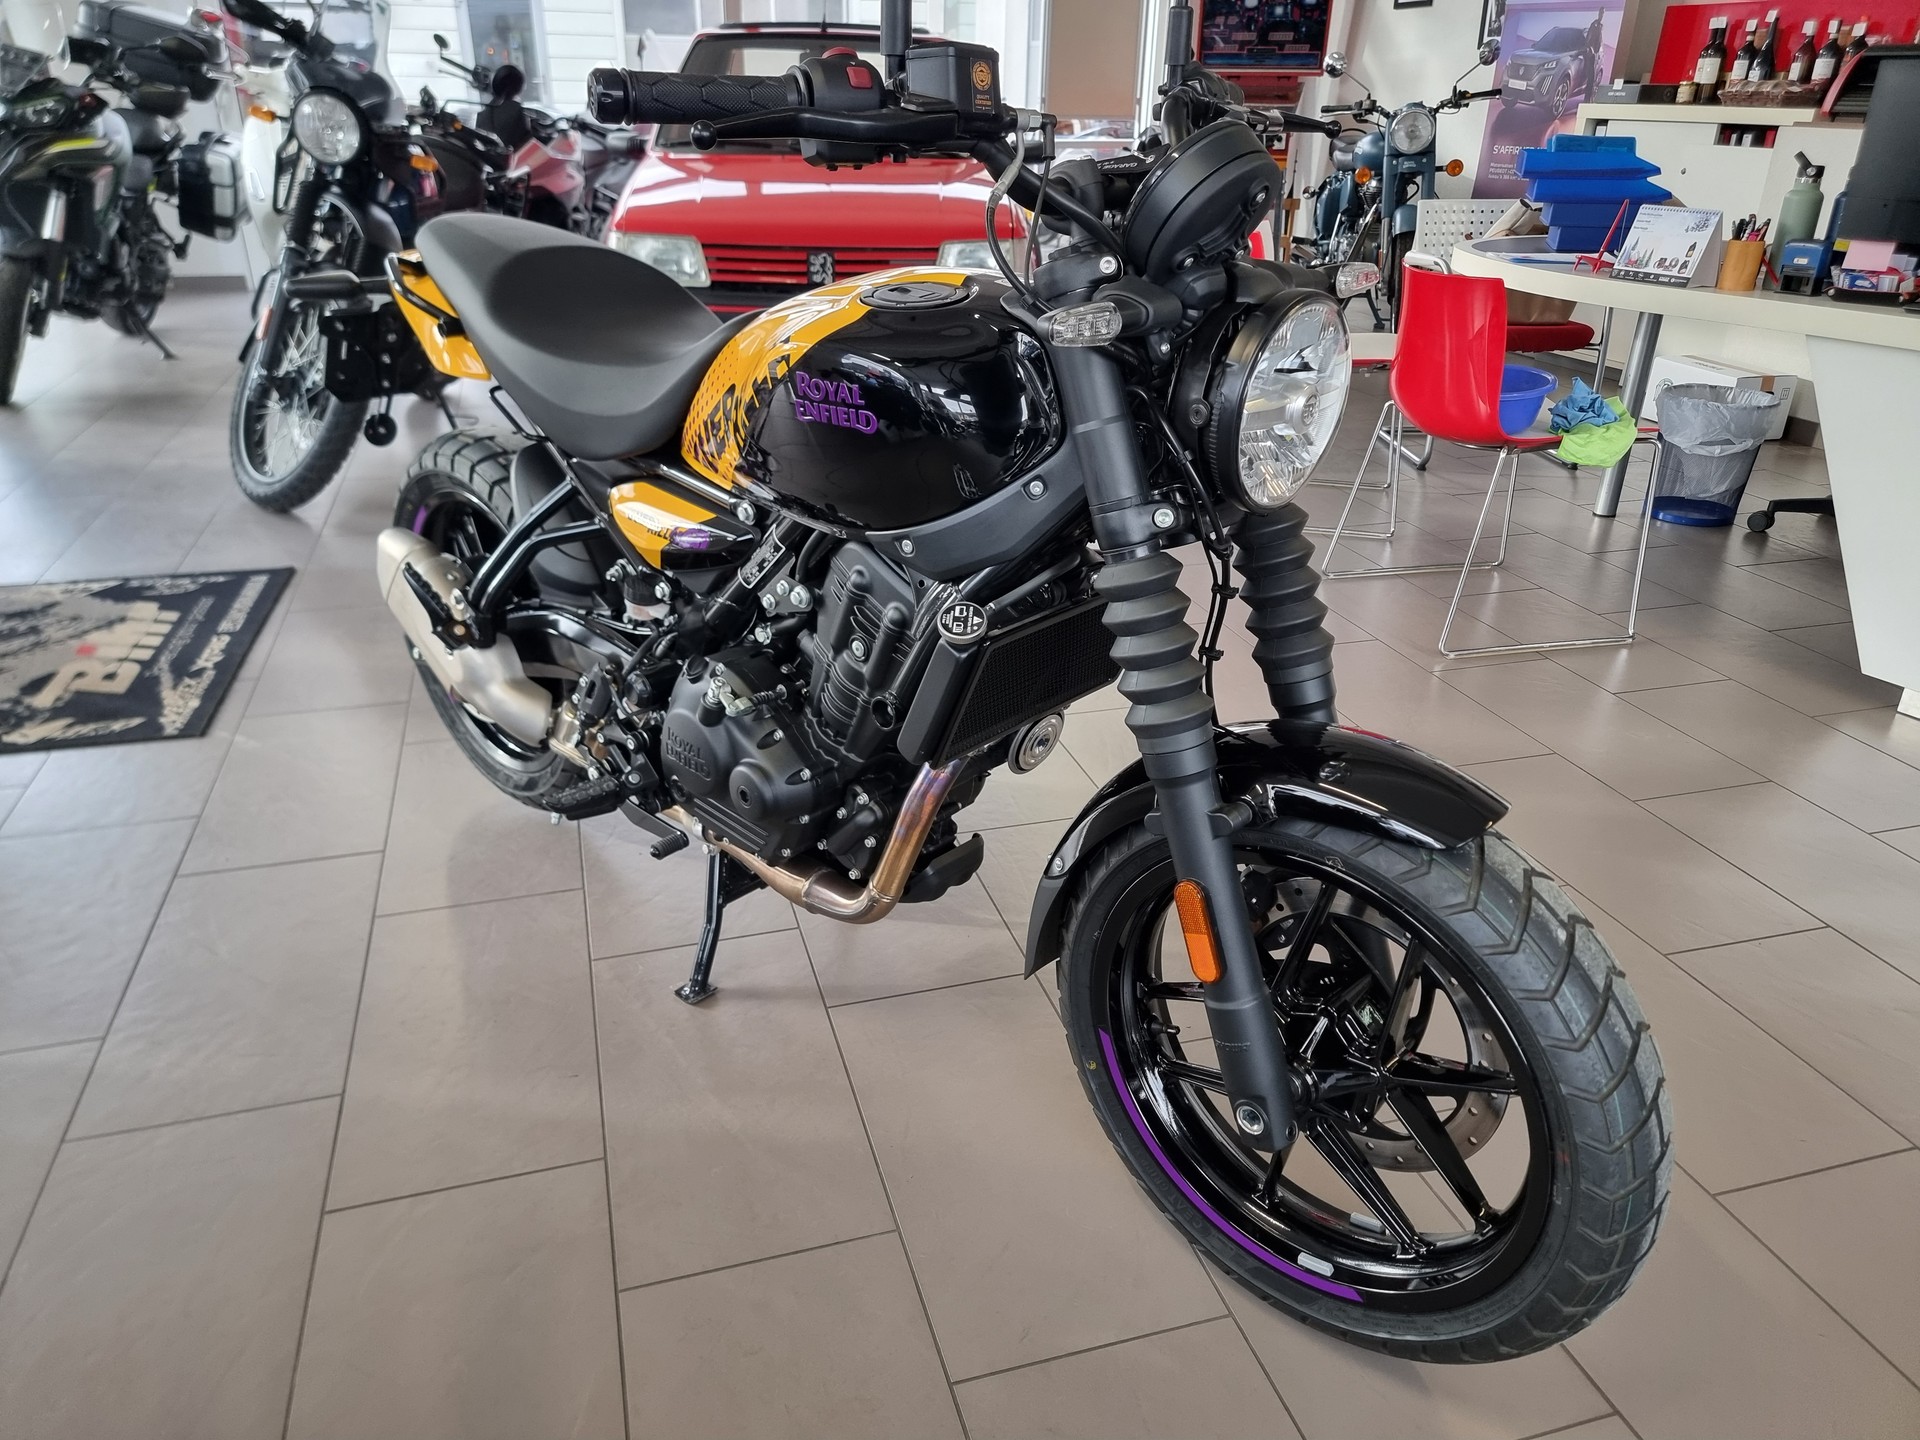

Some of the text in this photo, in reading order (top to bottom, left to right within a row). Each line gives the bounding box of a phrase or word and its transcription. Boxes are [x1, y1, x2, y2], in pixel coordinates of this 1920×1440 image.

[1492, 145, 1535, 155] S'AFFIR
[795, 371, 865, 406] ROYAL
[794, 399, 879, 435] ENFIELD
[667, 726, 706, 763] ROYAL
